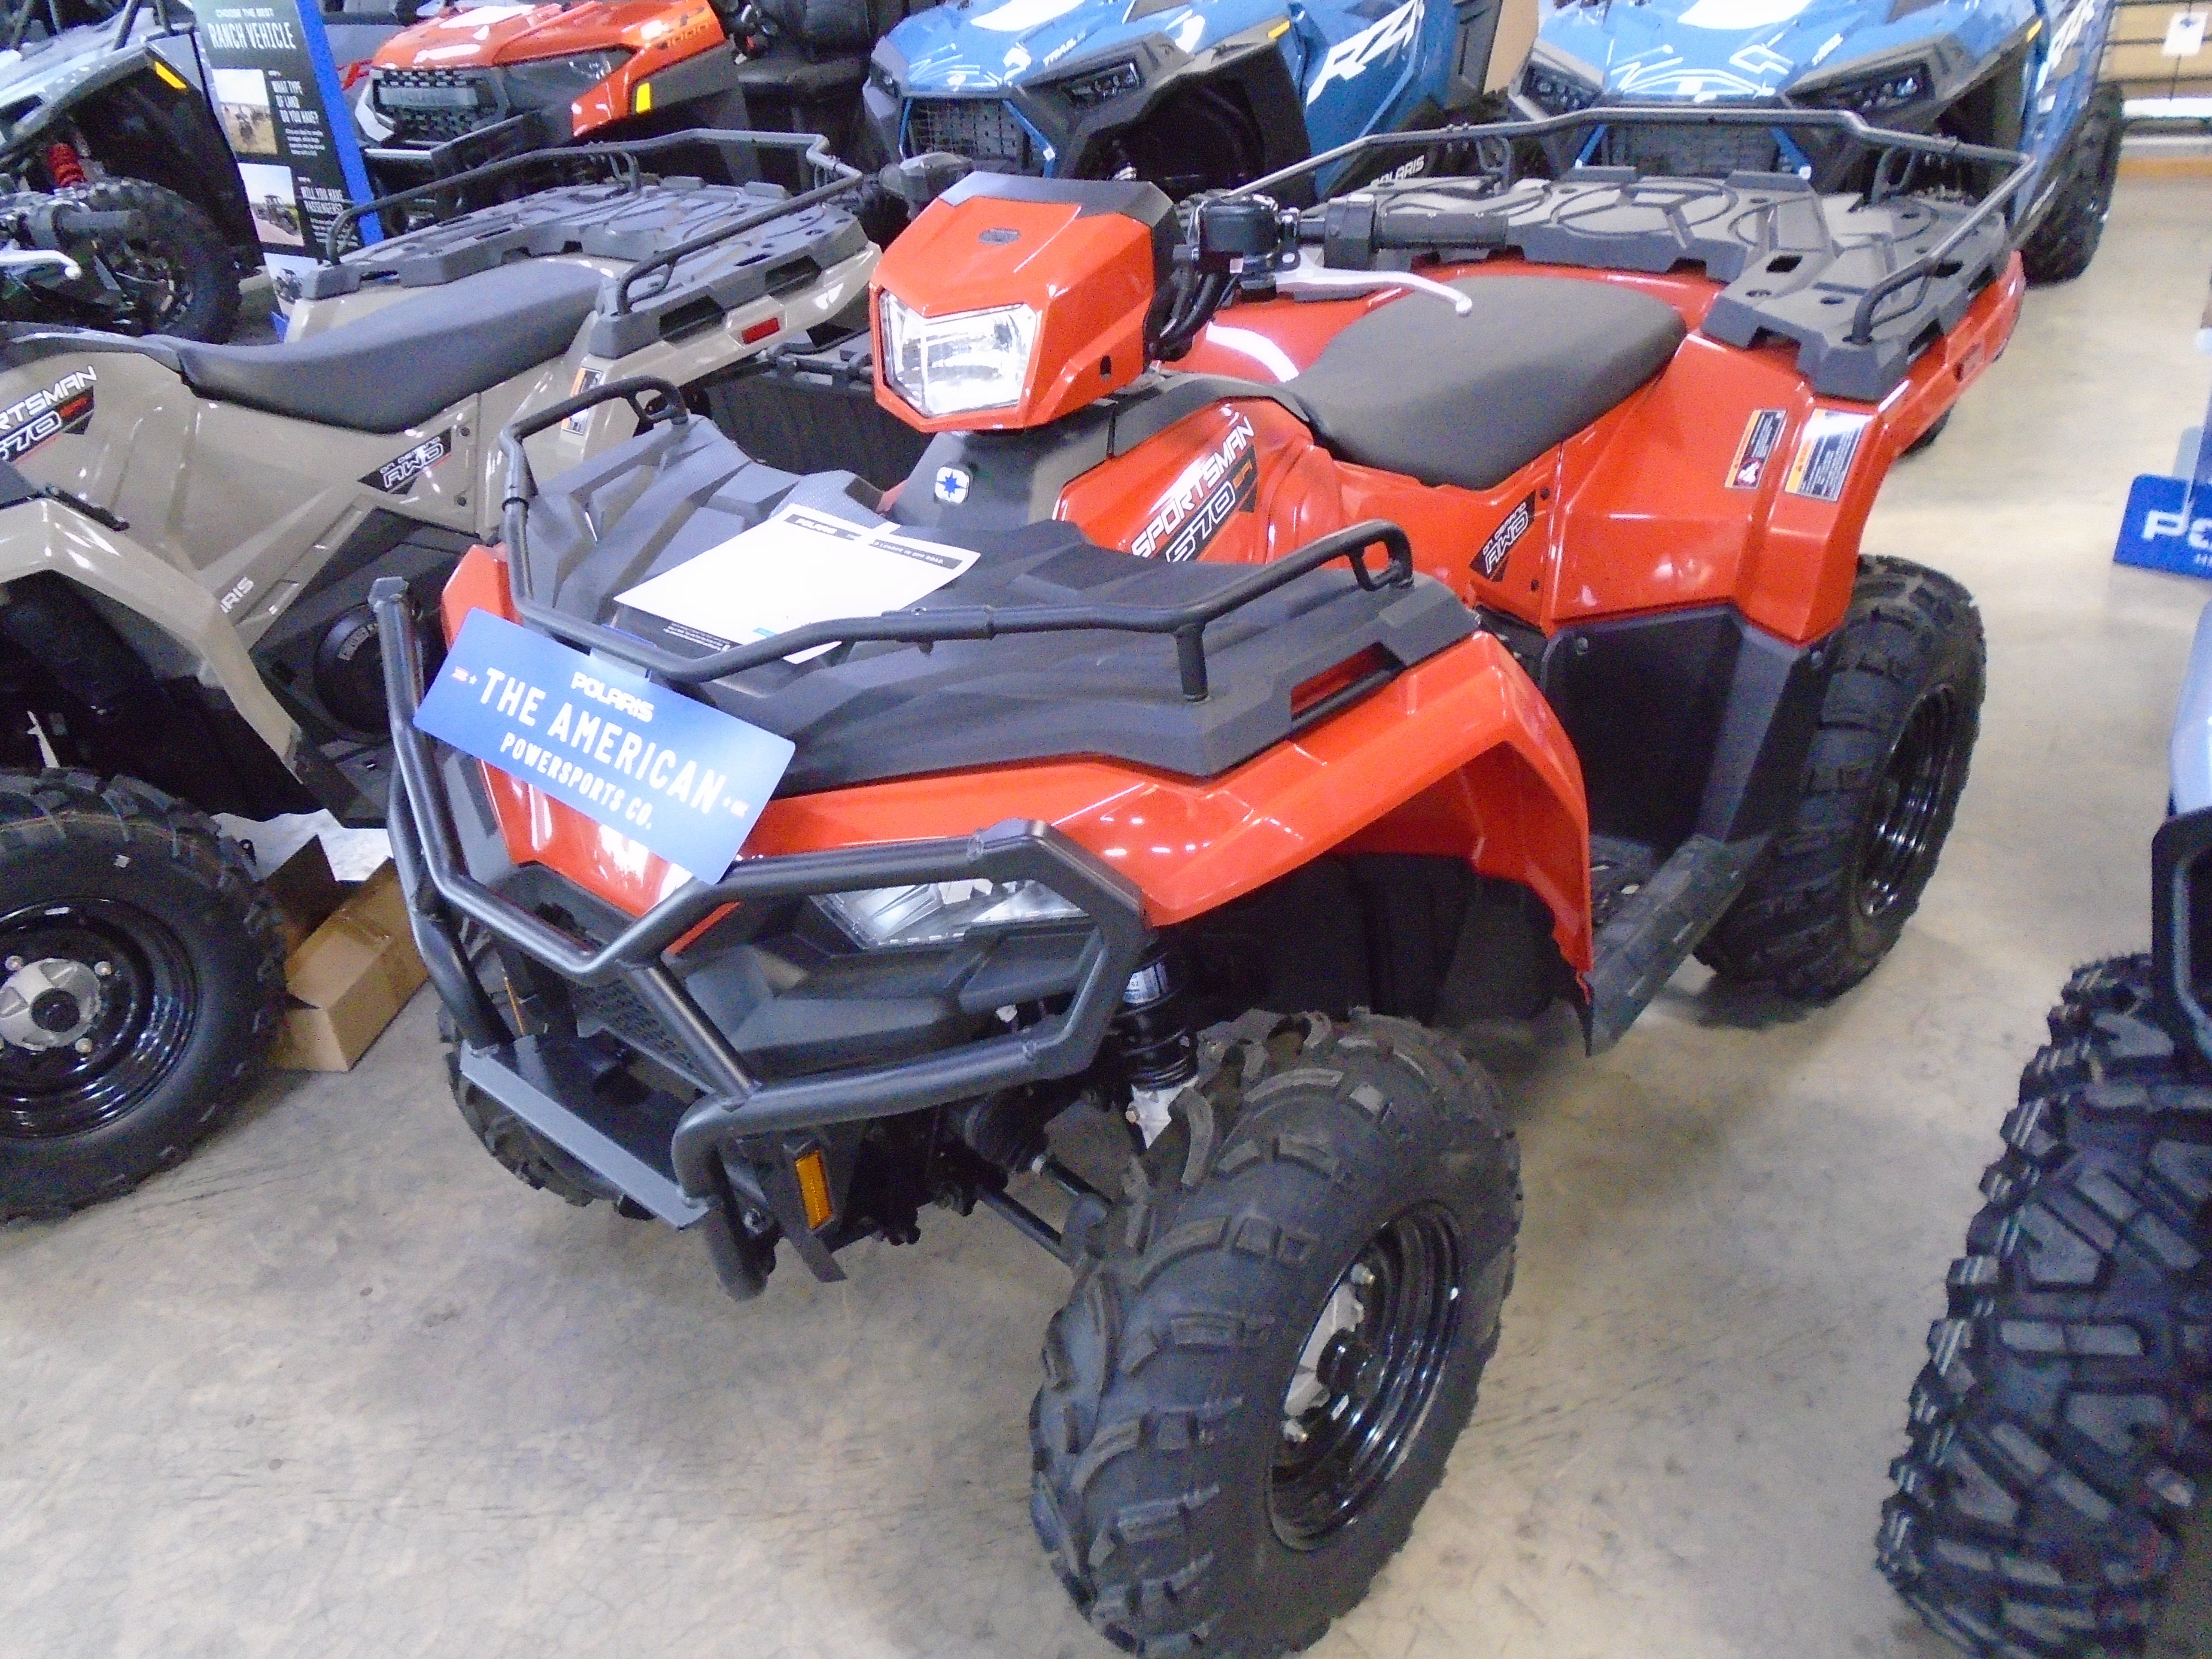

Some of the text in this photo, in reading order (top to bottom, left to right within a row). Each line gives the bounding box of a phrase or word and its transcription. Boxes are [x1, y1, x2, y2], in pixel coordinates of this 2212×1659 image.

[207, 22, 296, 49] RANCH VEHICLE
[289, 110, 302, 123] YOU
[315, 187, 329, 201] YOU
[383, 443, 444, 484] AWD
[1131, 416, 1254, 558] SPORTSMAN
[1166, 480, 1236, 563] 570
[1486, 510, 1528, 574] AWD
[571, 671, 654, 723] POLARIS
[480, 667, 727, 814] THE AMERICAN
[500, 731, 653, 830] POWERSPORTS CO.
